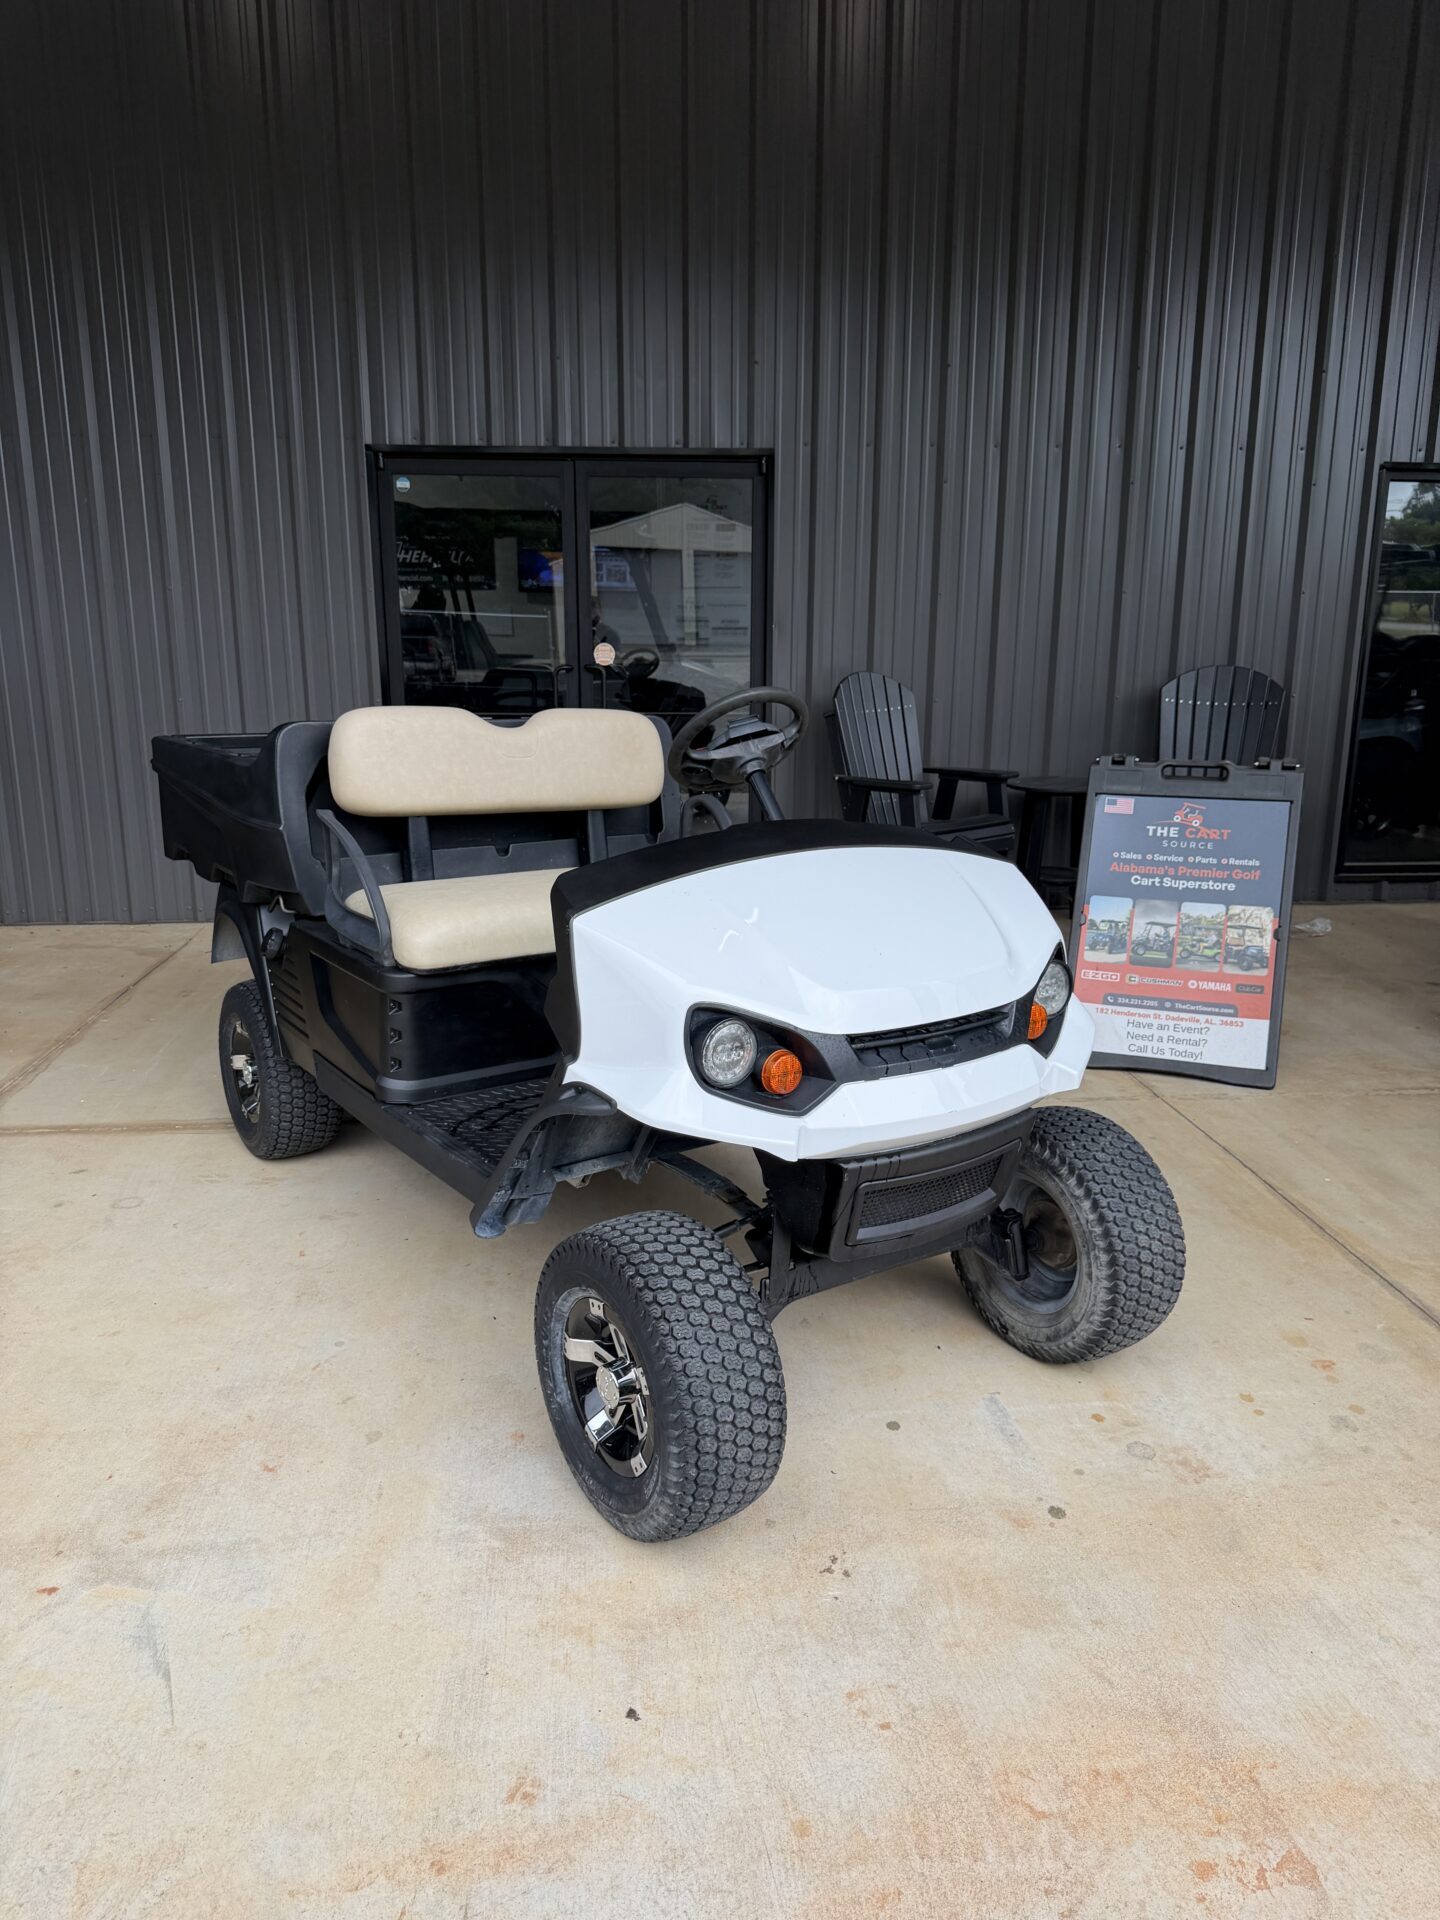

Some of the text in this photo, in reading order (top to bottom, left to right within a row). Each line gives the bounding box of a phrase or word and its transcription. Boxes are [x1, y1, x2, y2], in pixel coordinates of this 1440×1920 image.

[1146, 826, 1232, 840] THE CART
[1162, 839, 1214, 850] SOURCE
[1120, 852, 1260, 866] Sales Service Parts Rentals
[1110, 862, 1262, 881] Alabama's Premier Golf
[1131, 875, 1236, 891] Cart Superstore
[1082, 971, 1119, 981] EZGO
[1140, 976, 1183, 986] CUSHMAN
[1199, 981, 1232, 992] YAMAHA
[1175, 1002, 1234, 1014] TheCartSource.com
[1110, 1009, 1151, 1019] Henderson
[1165, 1014, 1202, 1025] Dadeville,
[1218, 1019, 1244, 1028] 36853
[1126, 1019, 1210, 1035] Have an Event?
[1126, 1031, 1154, 1042] Need
[1166, 1035, 1208, 1048] Rental?
[1128, 1043, 1203, 1061] Call Us Today!
